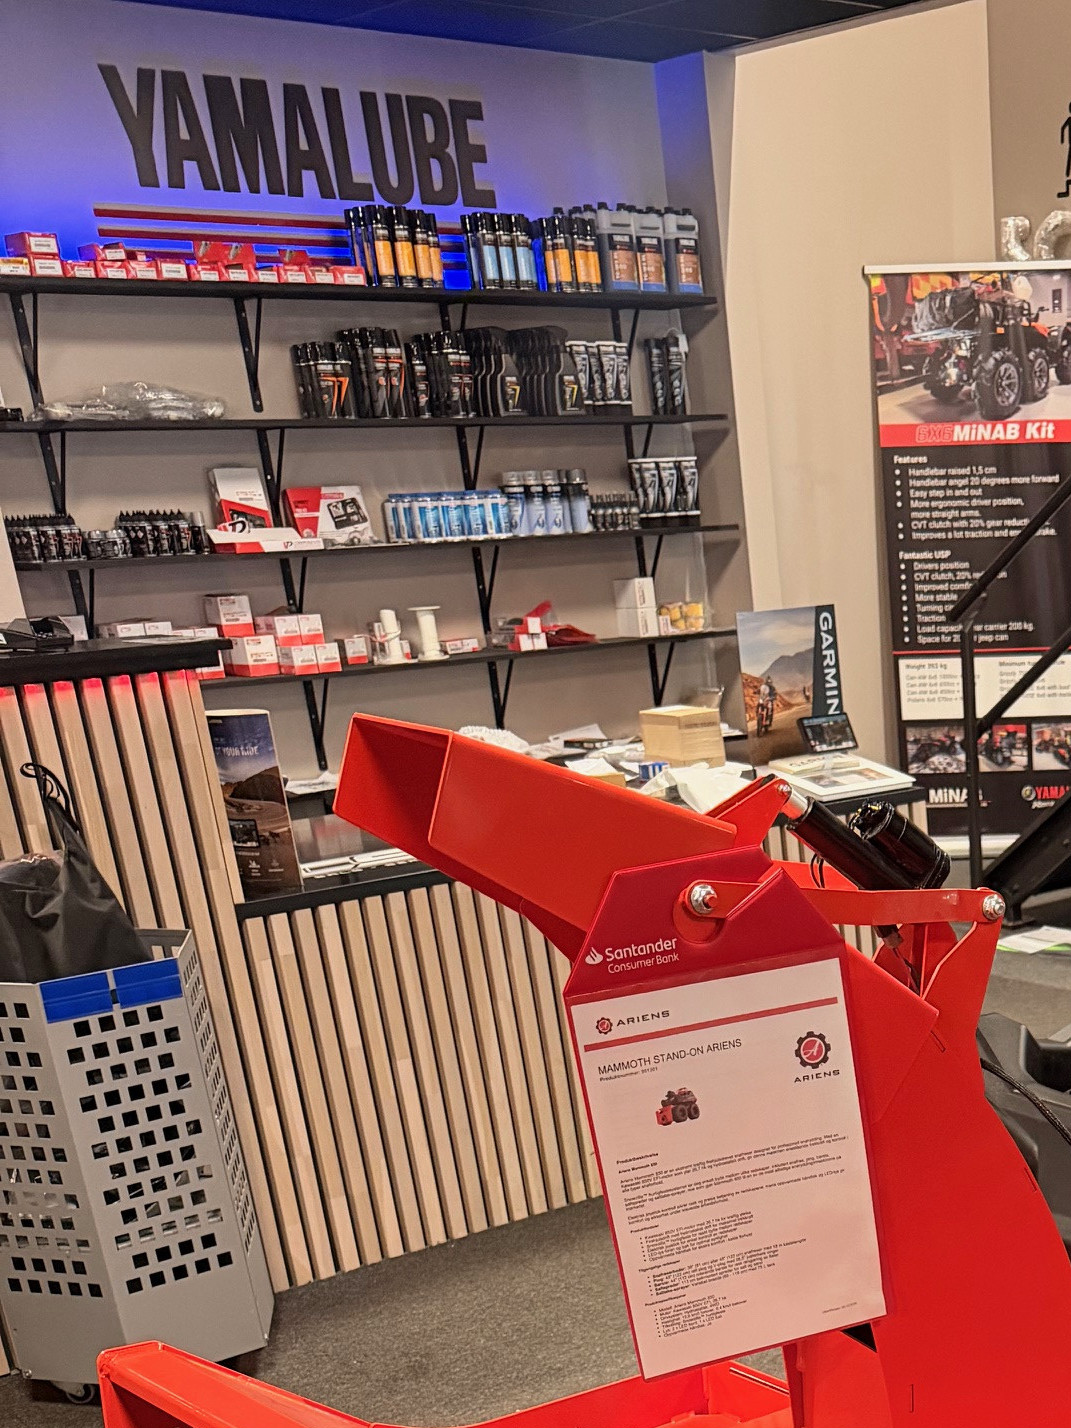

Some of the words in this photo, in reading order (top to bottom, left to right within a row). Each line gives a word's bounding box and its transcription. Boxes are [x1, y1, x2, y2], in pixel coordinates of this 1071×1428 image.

[98, 63, 498, 209] YAMALUBE
[1025, 421, 1055, 439] Kit
[894, 455, 928, 464] Features
[908, 467, 947, 476] Handlebar
[984, 466, 997, 474] cm
[909, 478, 947, 487] Handlebar
[981, 476, 1010, 486] degrees
[1011, 476, 1031, 484] more
[1031, 474, 1059, 483] forward
[910, 489, 928, 499] Easy
[910, 500, 930, 508] More
[899, 551, 934, 560] Fantastic
[934, 550, 952, 559] USP
[819, 611, 840, 714] GARMIN
[605, 937, 678, 962] Santander
[608, 957, 653, 975] Consumer
[655, 952, 679, 966] Bank
[616, 1010, 670, 1027] ARIENS
[598, 1056, 651, 1075] MAMMOTH
[653, 1045, 704, 1064] STAND-ON
[706, 1038, 742, 1055] ARIENS
[794, 1069, 841, 1084] ARIENS
